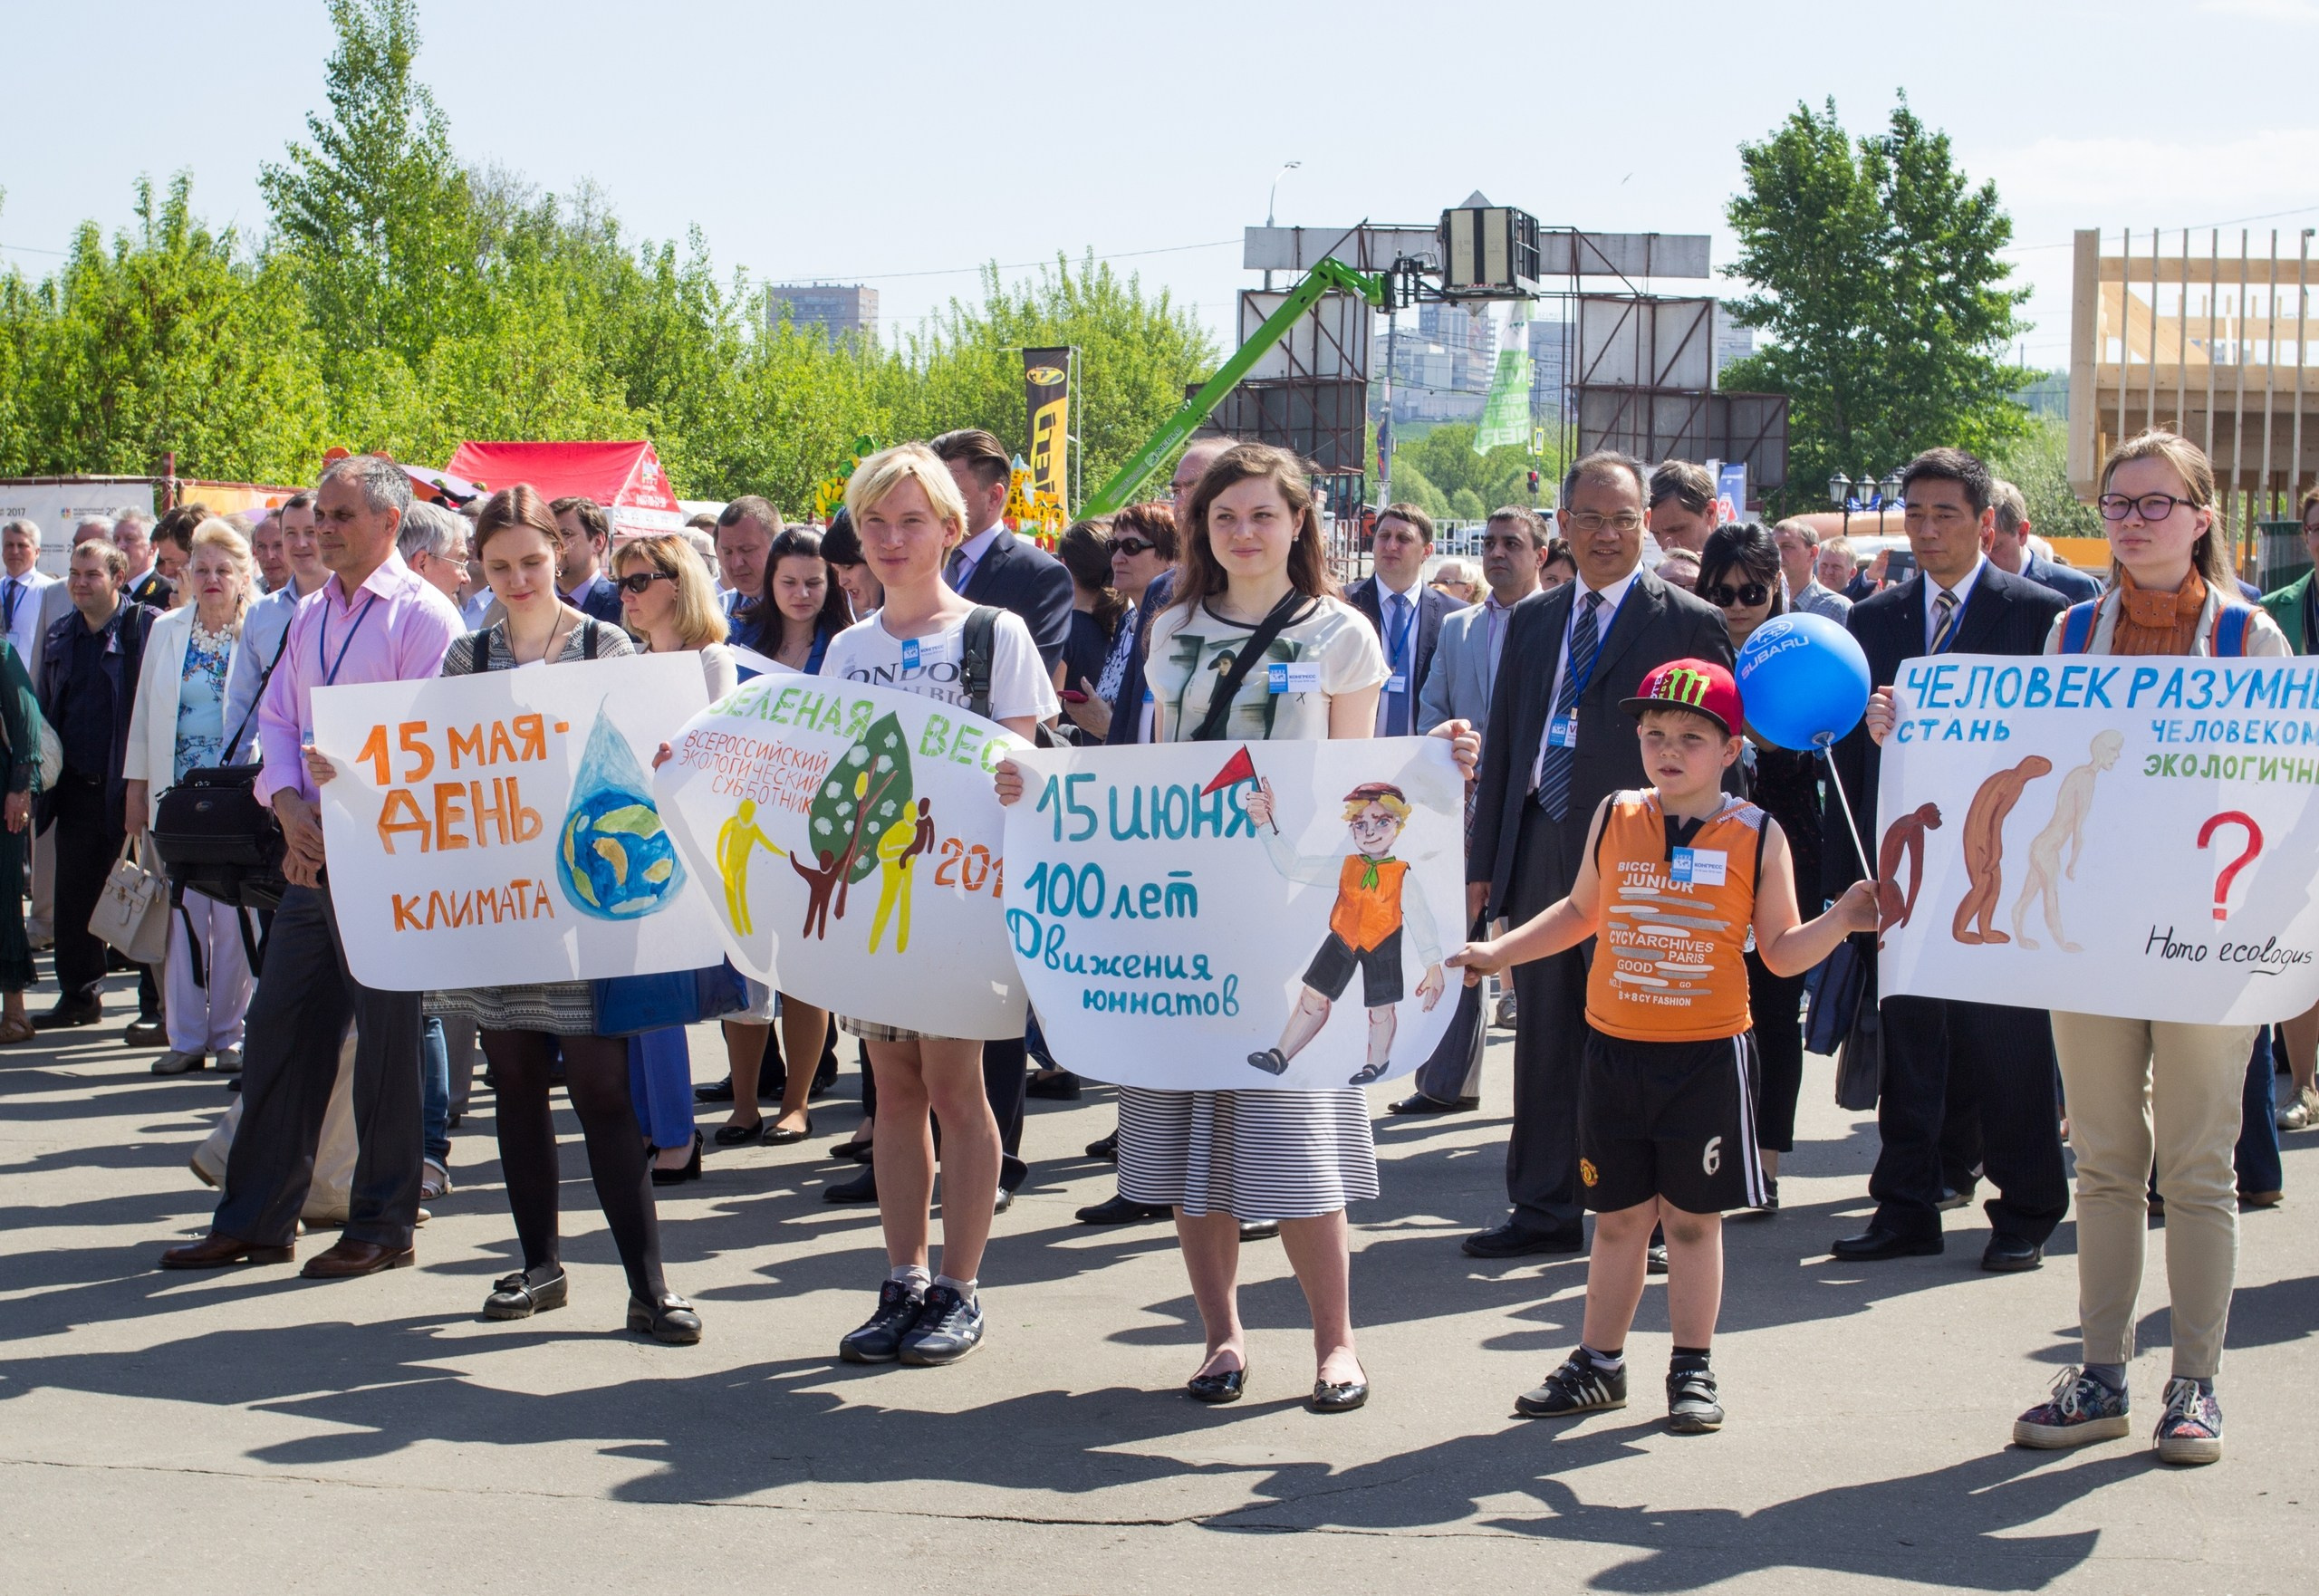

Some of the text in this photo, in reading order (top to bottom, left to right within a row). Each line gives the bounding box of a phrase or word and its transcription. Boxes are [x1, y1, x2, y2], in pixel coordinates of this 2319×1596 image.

[7, 507, 26, 517] 2017
[1741, 636, 1810, 680] SUBARU
[1907, 665, 2121, 709] ЧЕЛОВЕК
[708, 686, 875, 743] ЗЕЛЕНАЯ
[1896, 718, 2011, 744] СТАНЬ
[355, 721, 435, 785] 15
[679, 749, 823, 793] ЭКОЛОГИЧЕСКИЙ
[684, 729, 829, 774] ВСЕРОССИЙСКИЙ
[2143, 753, 2319, 784] ЭКОЛОГИЧН
[377, 776, 544, 855] ДЕНЬ
[712, 775, 813, 815] СУББОТНИК
[1036, 773, 1099, 842] 15
[1618, 861, 1656, 873] BICCI
[391, 879, 555, 932] КЛИМАТА
[1024, 861, 1198, 920] 100 лет
[1006, 908, 1214, 981] Движения
[1617, 959, 1653, 974] GOOD
[1668, 950, 1705, 964] PARIS
[2145, 924, 2314, 976] Homo ecologus
[1083, 973, 1240, 1017] юннатов
[1652, 995, 1692, 1006] FASHION
[1702, 1136, 1722, 1176] 6
